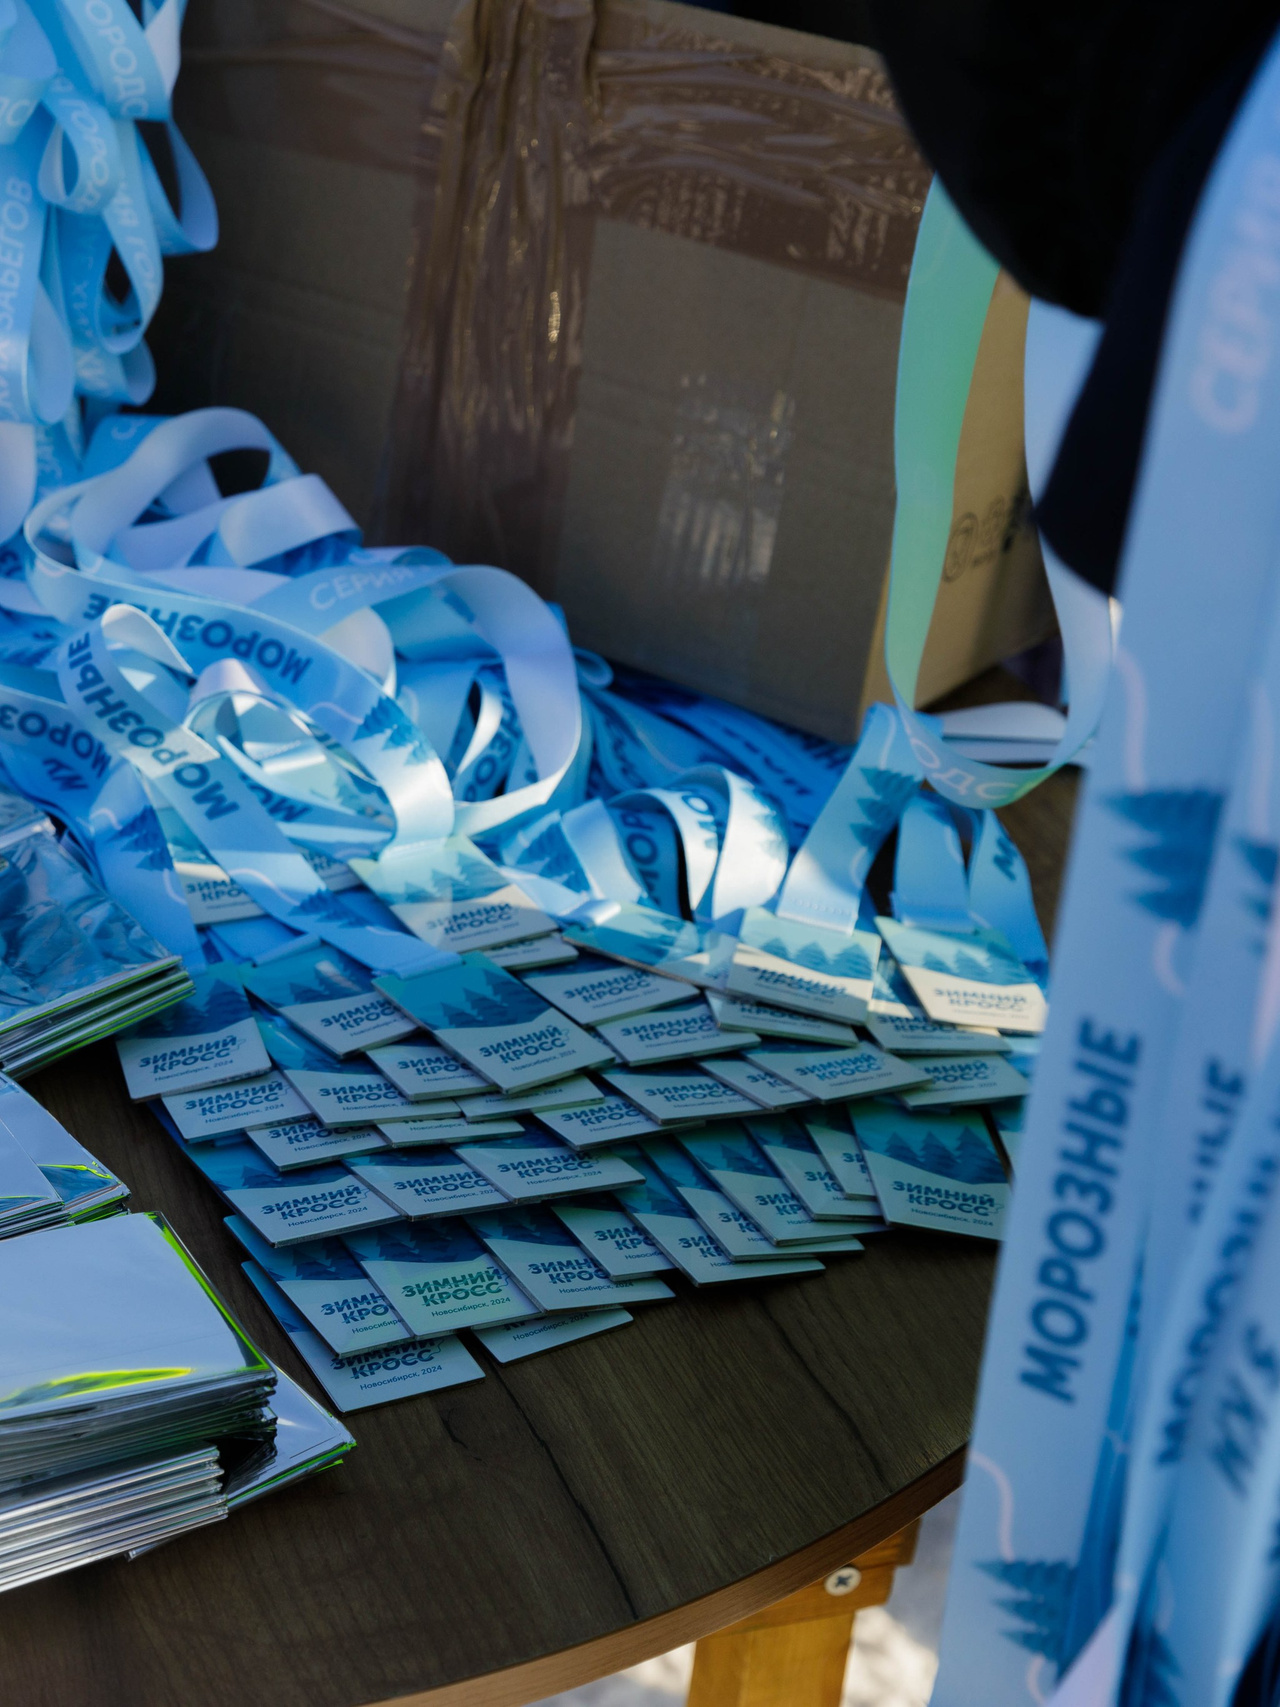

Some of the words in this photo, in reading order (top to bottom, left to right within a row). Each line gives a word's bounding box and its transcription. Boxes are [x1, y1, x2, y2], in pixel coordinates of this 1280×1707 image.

[84, 1, 149, 117] ОРОДС
[310, 565, 416, 610] СЕРИЯ
[83, 593, 313, 686] МОРОЗНЕ
[68, 631, 240, 822] МОРОЗНЫЕ
[444, 913, 512, 936] КРОСС
[581, 978, 651, 1003] КРОСС
[933, 987, 1026, 1004] ЗИМНИЙ
[949, 998, 1024, 1012] КРОСС
[479, 1025, 563, 1058] ЗИМНИЙ
[638, 1024, 713, 1042] КРОСС
[139, 1035, 237, 1068] ЗИМНИЙ
[152, 1048, 230, 1074] КРОСС
[499, 1037, 566, 1064] КРОСС
[213, 1059, 234, 1068] 2024
[794, 1053, 879, 1077] ЗИМНИЙ
[816, 1063, 883, 1082] КРОСС
[924, 1060, 989, 1075] МНИЙ
[932, 1072, 989, 1084] РОСС
[185, 1081, 283, 1110] ЗИМНИЙ
[200, 1092, 279, 1116] КРОСС
[265, 1103, 285, 1111] 2024
[579, 1109, 641, 1126] КРОС
[268, 1122, 322, 1139] ЗИМ
[353, 1131, 372, 1141] 2024
[516, 1159, 593, 1179] КРОСС
[582, 1169, 602, 1178] 2024
[260, 1184, 362, 1216] ЗИМНИЙ
[892, 1180, 995, 1208] ЗИМНИЙ
[908, 1194, 990, 1217] КРОСС
[278, 1195, 360, 1221] КРОСС
[287, 1211, 346, 1228] Новосибирск,
[347, 1206, 368, 1216] 2024
[1019, 1015, 1142, 1404] МОРОЗНЫЕ
[594, 1226, 641, 1242] ЗИМ
[973, 1218, 994, 1227] 2024
[614, 1237, 656, 1251] КРО
[401, 1266, 502, 1298] ЗИМНИЙ
[549, 1269, 609, 1284] КРОС
[320, 1292, 386, 1316] ЗИМН
[421, 1281, 502, 1307] КРОСС
[342, 1303, 391, 1325] КРО
[431, 1301, 489, 1318] Новосибирск,
[490, 1296, 511, 1306] 2024
[569, 1311, 590, 1324] 2024
[350, 1349, 434, 1380] КРОСС
[359, 1371, 420, 1391] Новосибирск,
[421, 1364, 443, 1375] 2024
